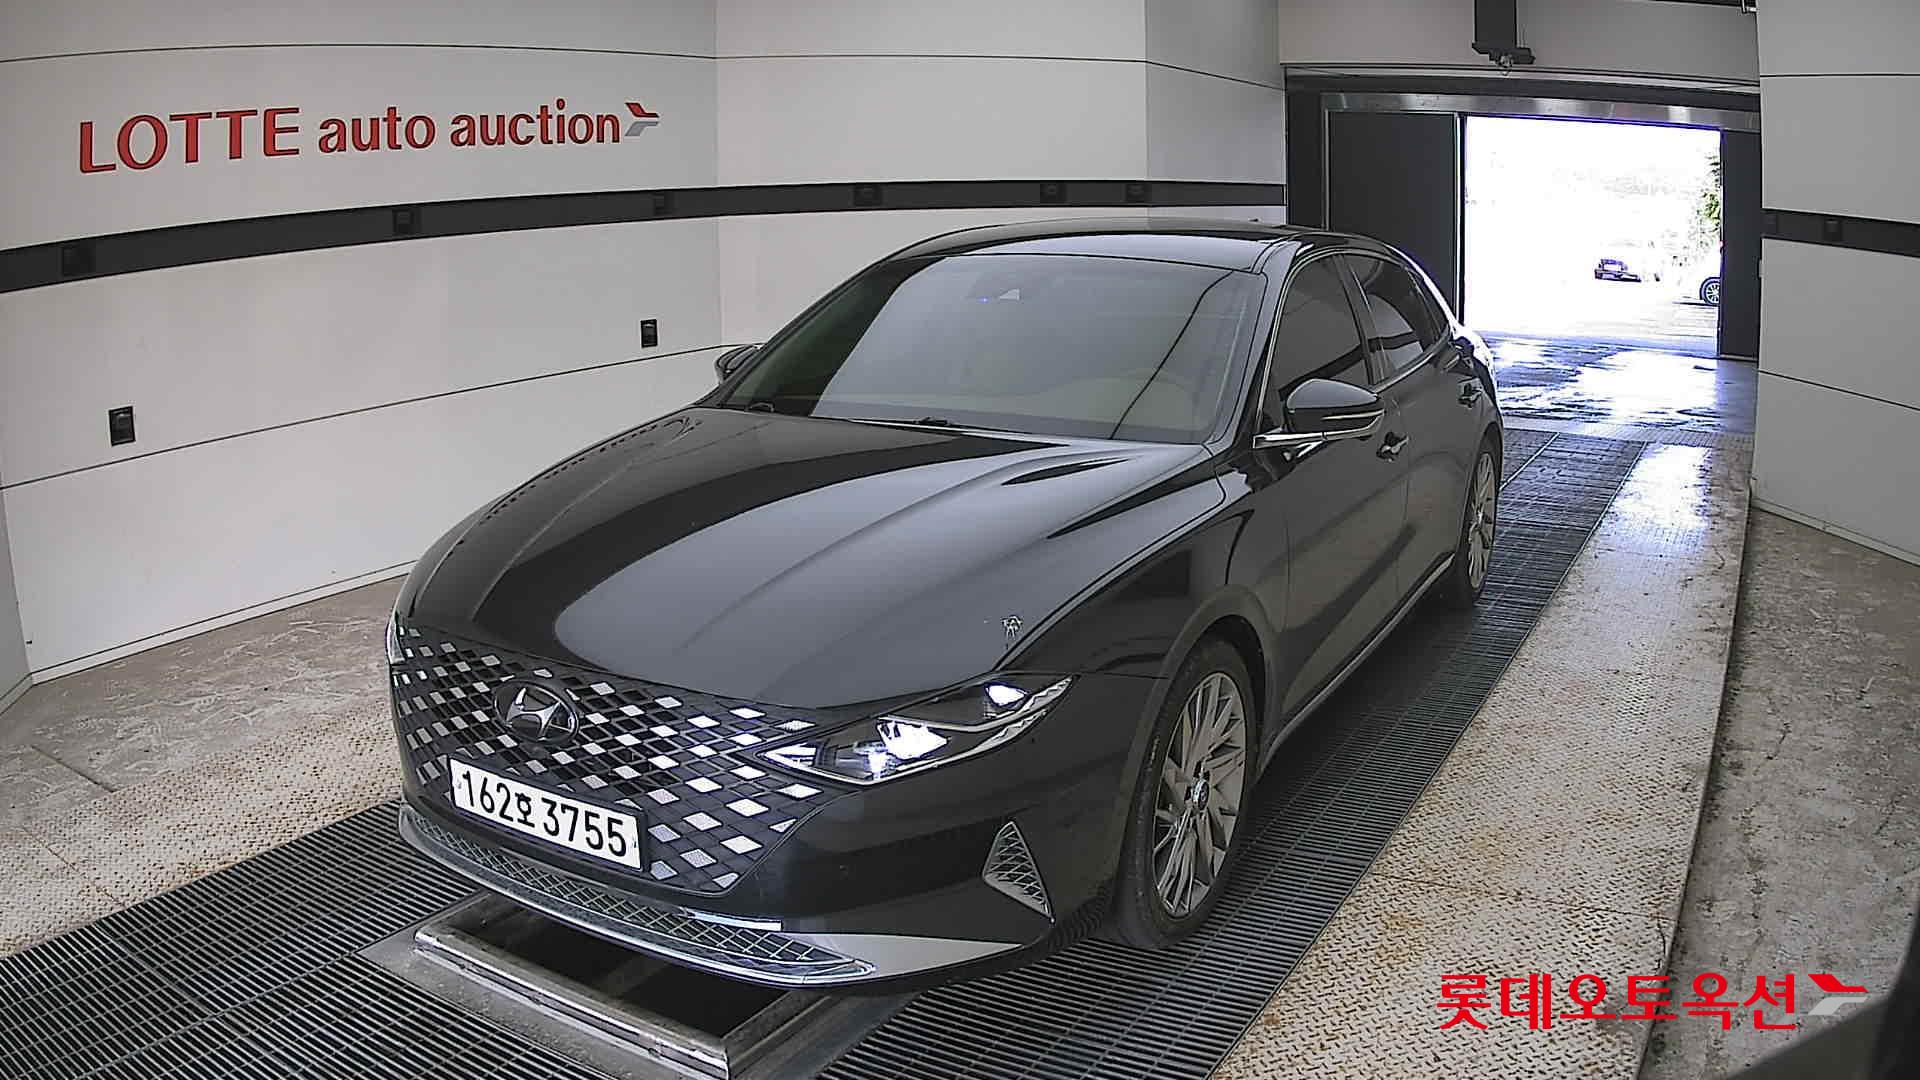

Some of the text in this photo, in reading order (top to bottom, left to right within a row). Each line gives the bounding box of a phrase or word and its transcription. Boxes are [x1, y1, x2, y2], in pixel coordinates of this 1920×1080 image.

[79, 98, 622, 174] LOTTE auto auction
